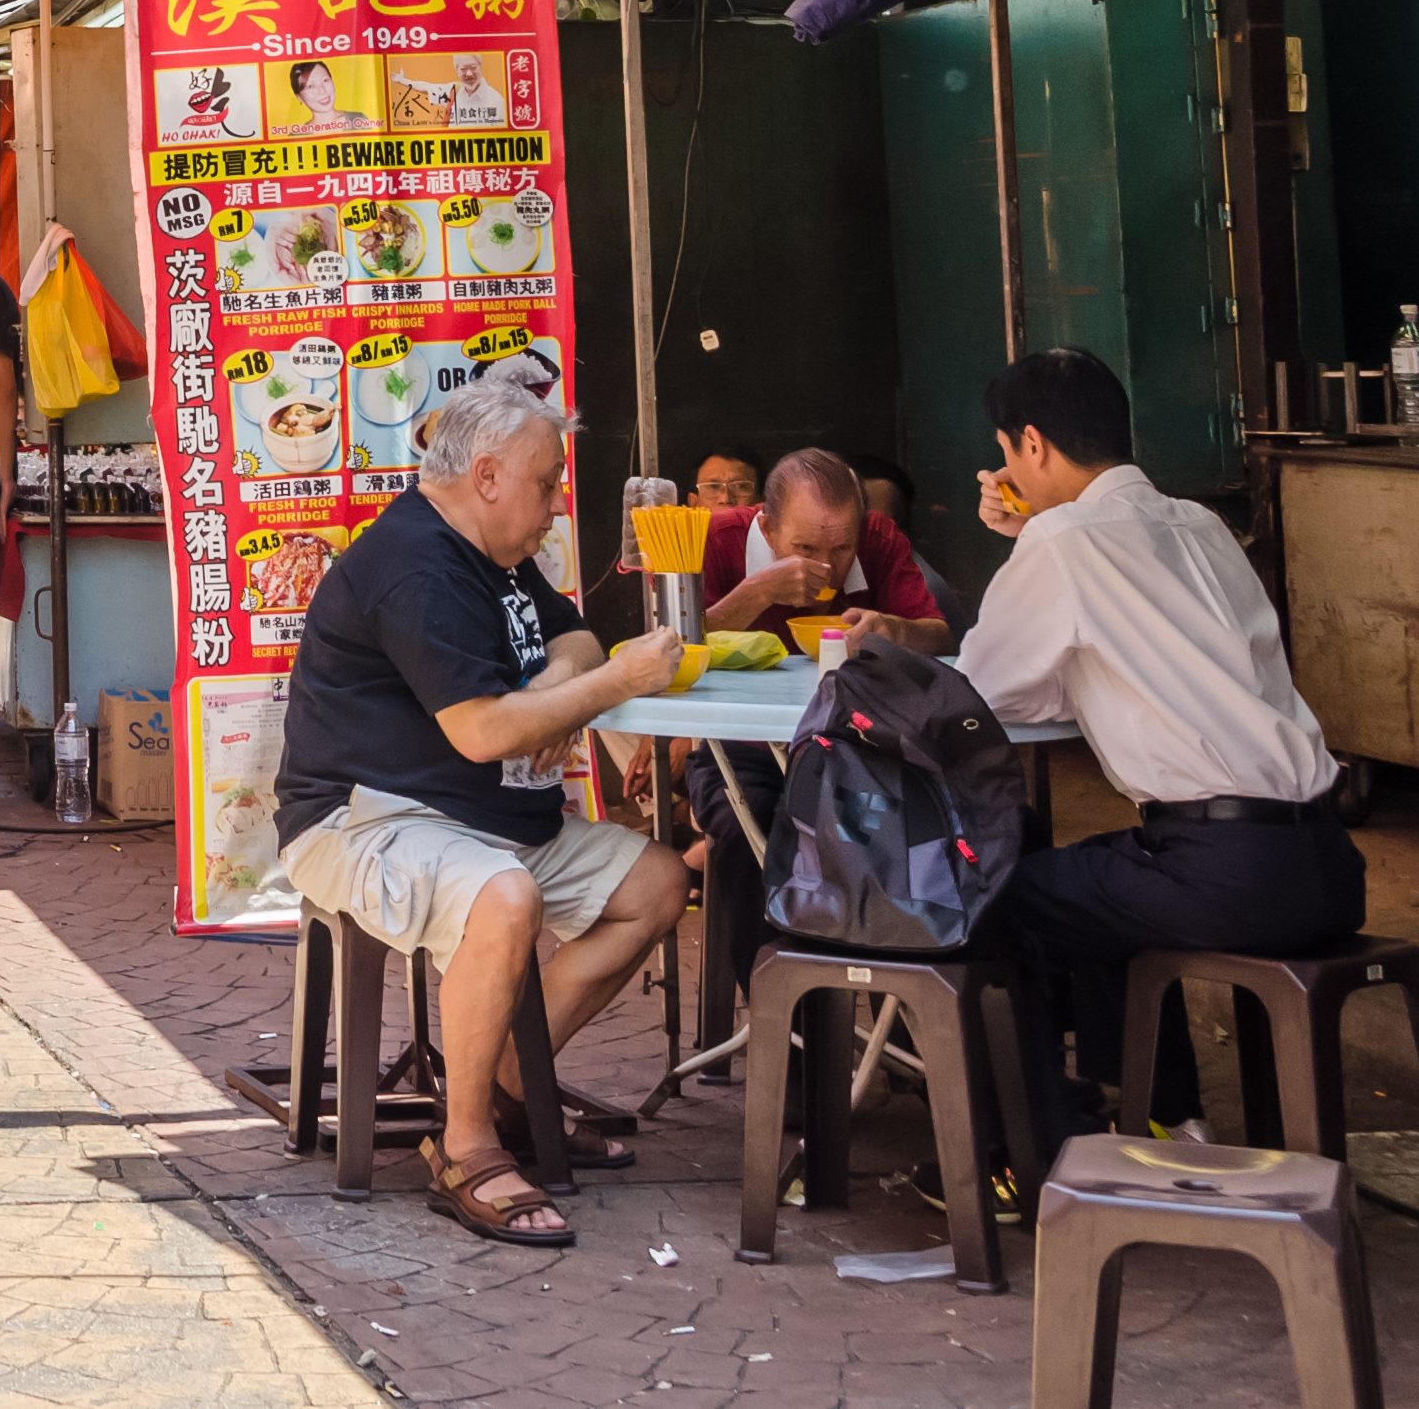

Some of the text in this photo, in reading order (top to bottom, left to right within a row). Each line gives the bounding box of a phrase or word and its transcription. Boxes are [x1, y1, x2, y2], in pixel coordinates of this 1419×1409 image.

[263, 26, 428, 57] Since 1949
[271, 117, 384, 135] 3rd Generation Owner
[162, 130, 221, 143] HO CHAK!
[326, 136, 544, 169] BEWARE OF IMITATION
[164, 145, 320, 181] 提防冒充!!!
[162, 193, 201, 217] NO
[343, 201, 378, 227] RM5.50
[442, 197, 480, 223] RM5.50
[166, 213, 205, 233] MSG
[218, 209, 244, 237] RM7
[351, 302, 444, 317] CRISPY INNARDS
[453, 298, 557, 312] HOME MADE PORK BALL
[223, 308, 347, 326] FRESH RAW FISH
[369, 317, 425, 330] PORRIDGE
[484, 313, 528, 325] PORRIDGE
[248, 320, 324, 337] PORRIDGE
[227, 351, 269, 380] RM18
[437, 367, 467, 391] OR
[248, 497, 337, 513] FRESH FROG
[349, 494, 393, 506] TENDER
[257, 510, 331, 524] PORRIDGE
[252, 647, 282, 658] SECRET
[128, 722, 171, 750] Sea
